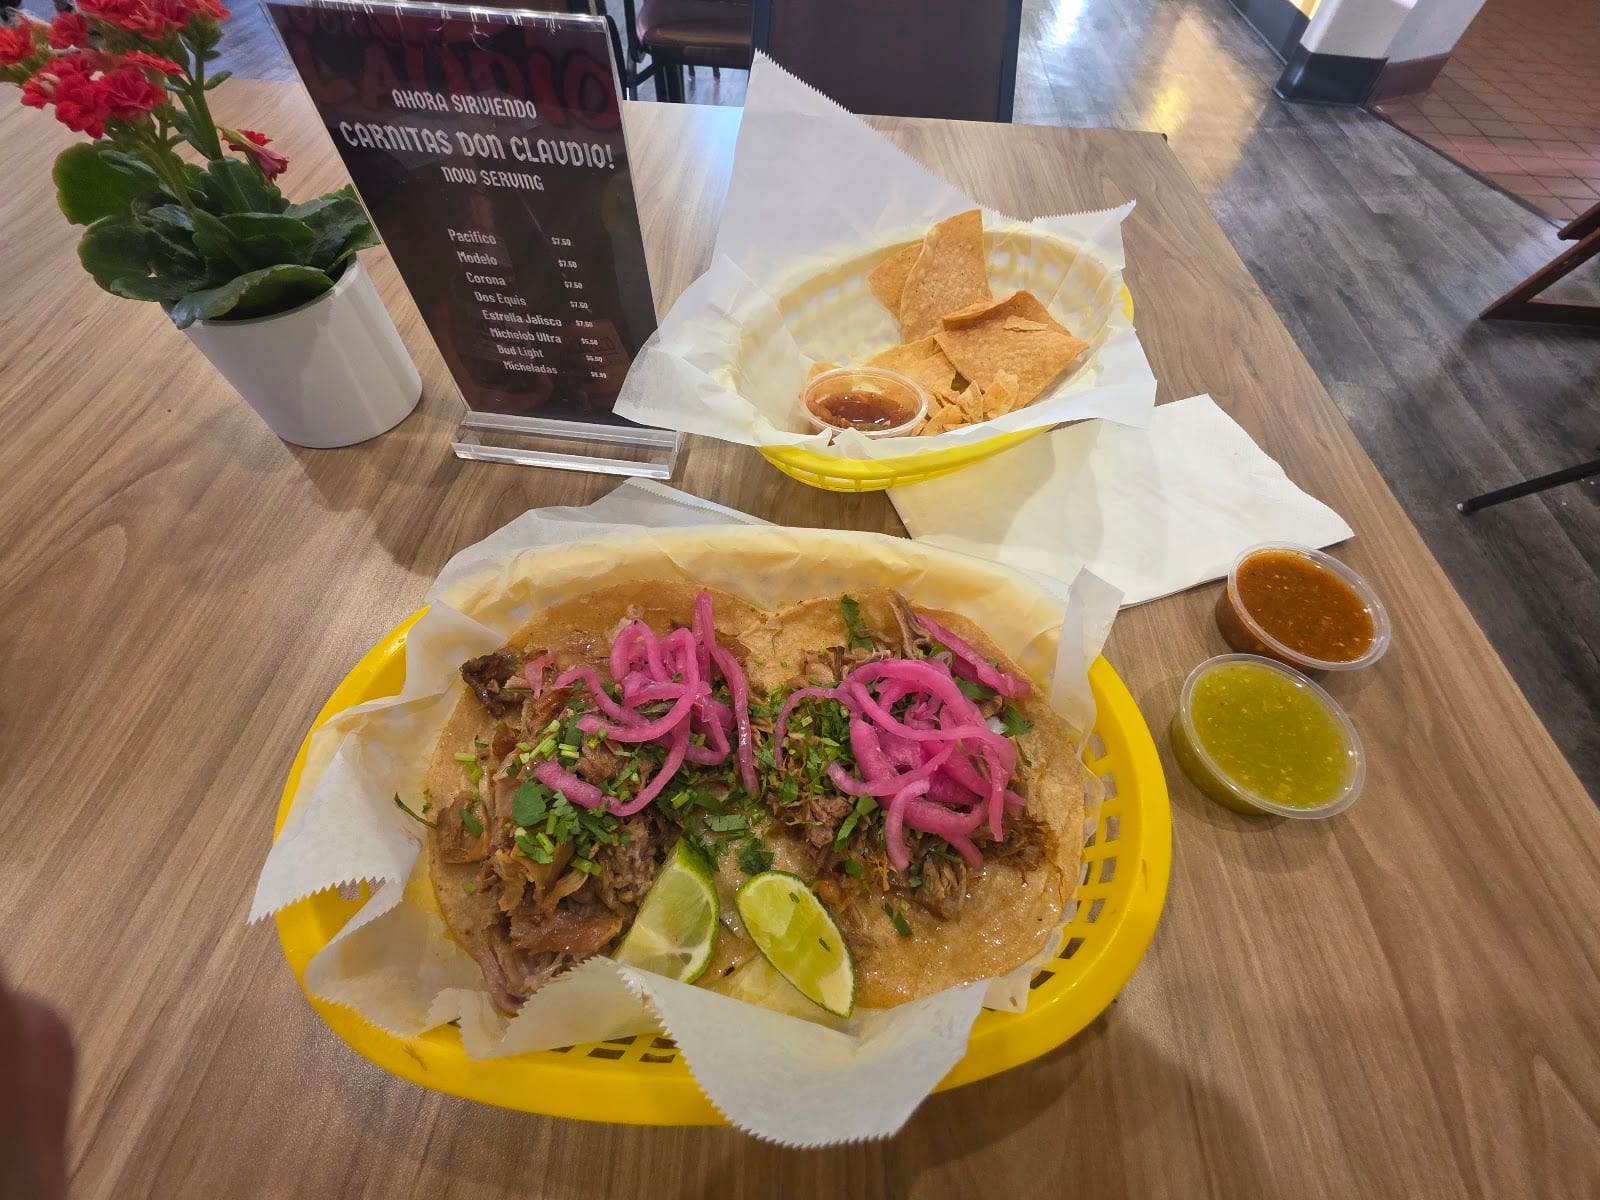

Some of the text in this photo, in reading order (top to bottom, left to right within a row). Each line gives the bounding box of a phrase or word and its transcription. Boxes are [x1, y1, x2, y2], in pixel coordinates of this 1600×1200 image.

[391, 88, 538, 120] AHORA SIRVIENDO
[339, 120, 616, 170] CARNITAS DON CLAUDIO!
[441, 165, 545, 191] NOW SERVING
[447, 228, 572, 247] Pacifico $7.50
[456, 250, 578, 269] Modelo $7.50
[465, 271, 583, 290] Corona $7.50
[474, 291, 496, 304] Dos
[496, 293, 527, 307] Equis
[482, 309, 524, 324] Estrella
[525, 313, 563, 327] Jalisco
[489, 327, 535, 341] Michelob
[536, 331, 562, 344] Ultra
[496, 344, 517, 355] Bud
[517, 346, 545, 359] Light
[503, 360, 559, 375] Micheladas
